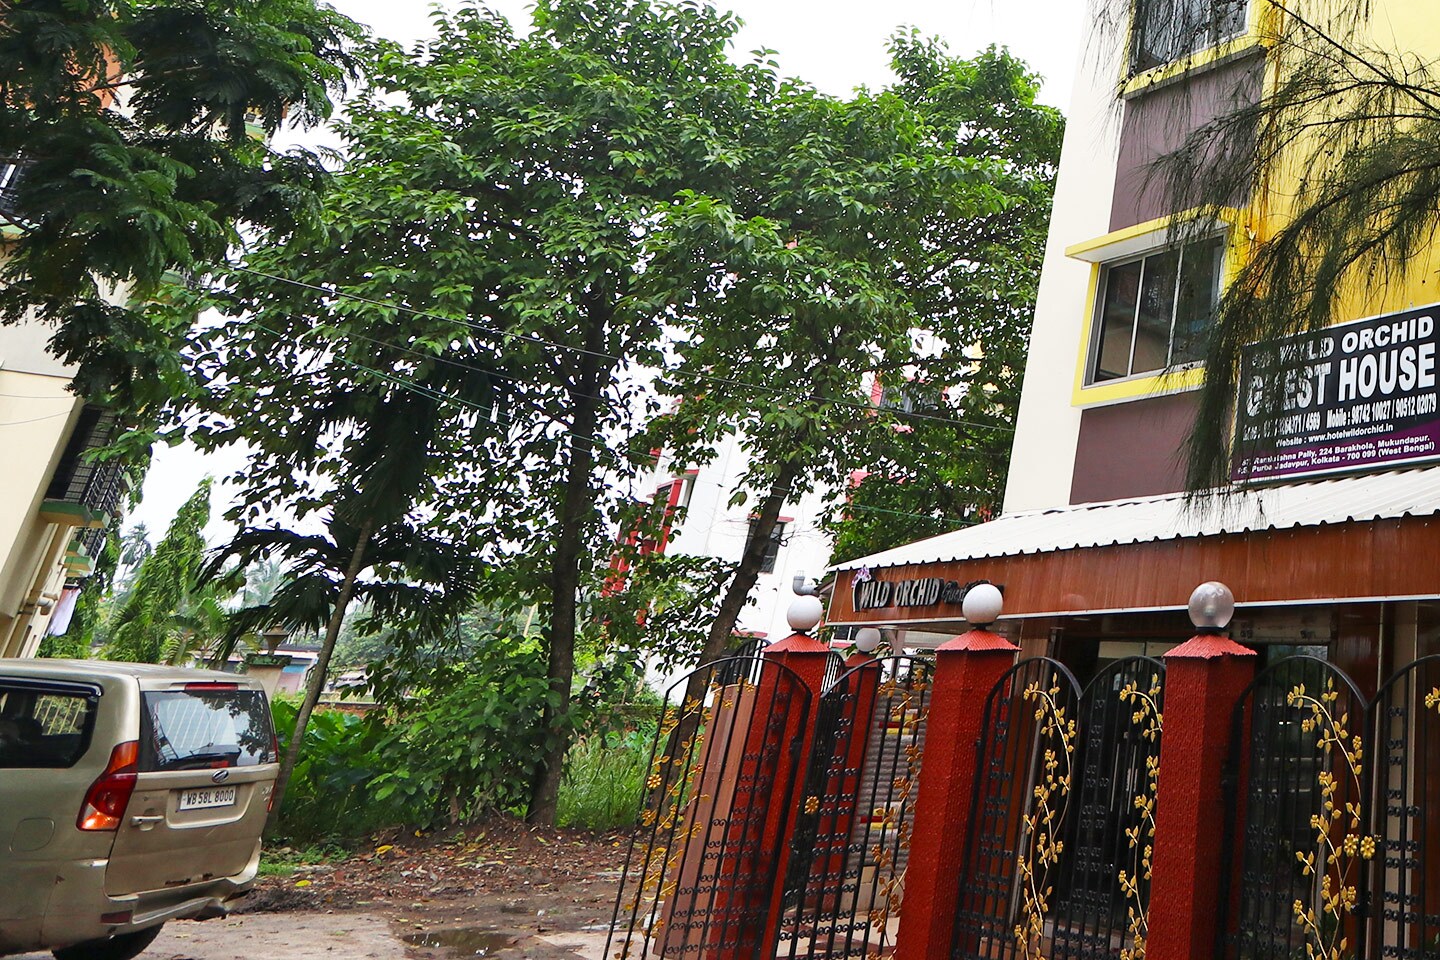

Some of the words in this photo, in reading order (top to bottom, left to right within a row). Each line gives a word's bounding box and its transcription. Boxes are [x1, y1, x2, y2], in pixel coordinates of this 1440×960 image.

[1341, 315, 1434, 353] ORCHID
[1338, 342, 1436, 402] HOUSE
[1326, 408, 1347, 429] Mobile
[1351, 403, 1371, 425] 98742
[1372, 400, 1391, 422] 10027
[1395, 396, 1415, 418] 90512
[1416, 392, 1437, 415] 02079
[1307, 423, 1394, 443] www.hotelwildorchid.in
[1275, 459, 1310, 470] Jadavpur,
[1311, 453, 1340, 466] Kolkata
[1346, 452, 1360, 461] 700
[1361, 449, 1376, 459] 099
[1378, 446, 1401, 458] (West
[1403, 441, 1435, 453] Bengal)
[1298, 449, 1317, 459] Pally,
[1318, 447, 1333, 456] 224
[1334, 441, 1375, 454] Barakhola,
[859, 581, 892, 610] WILD
[894, 578, 942, 607] ORCHID
[186, 792, 197, 805] WB
[198, 790, 212, 804] 58L
[214, 789, 234, 802] 8000
